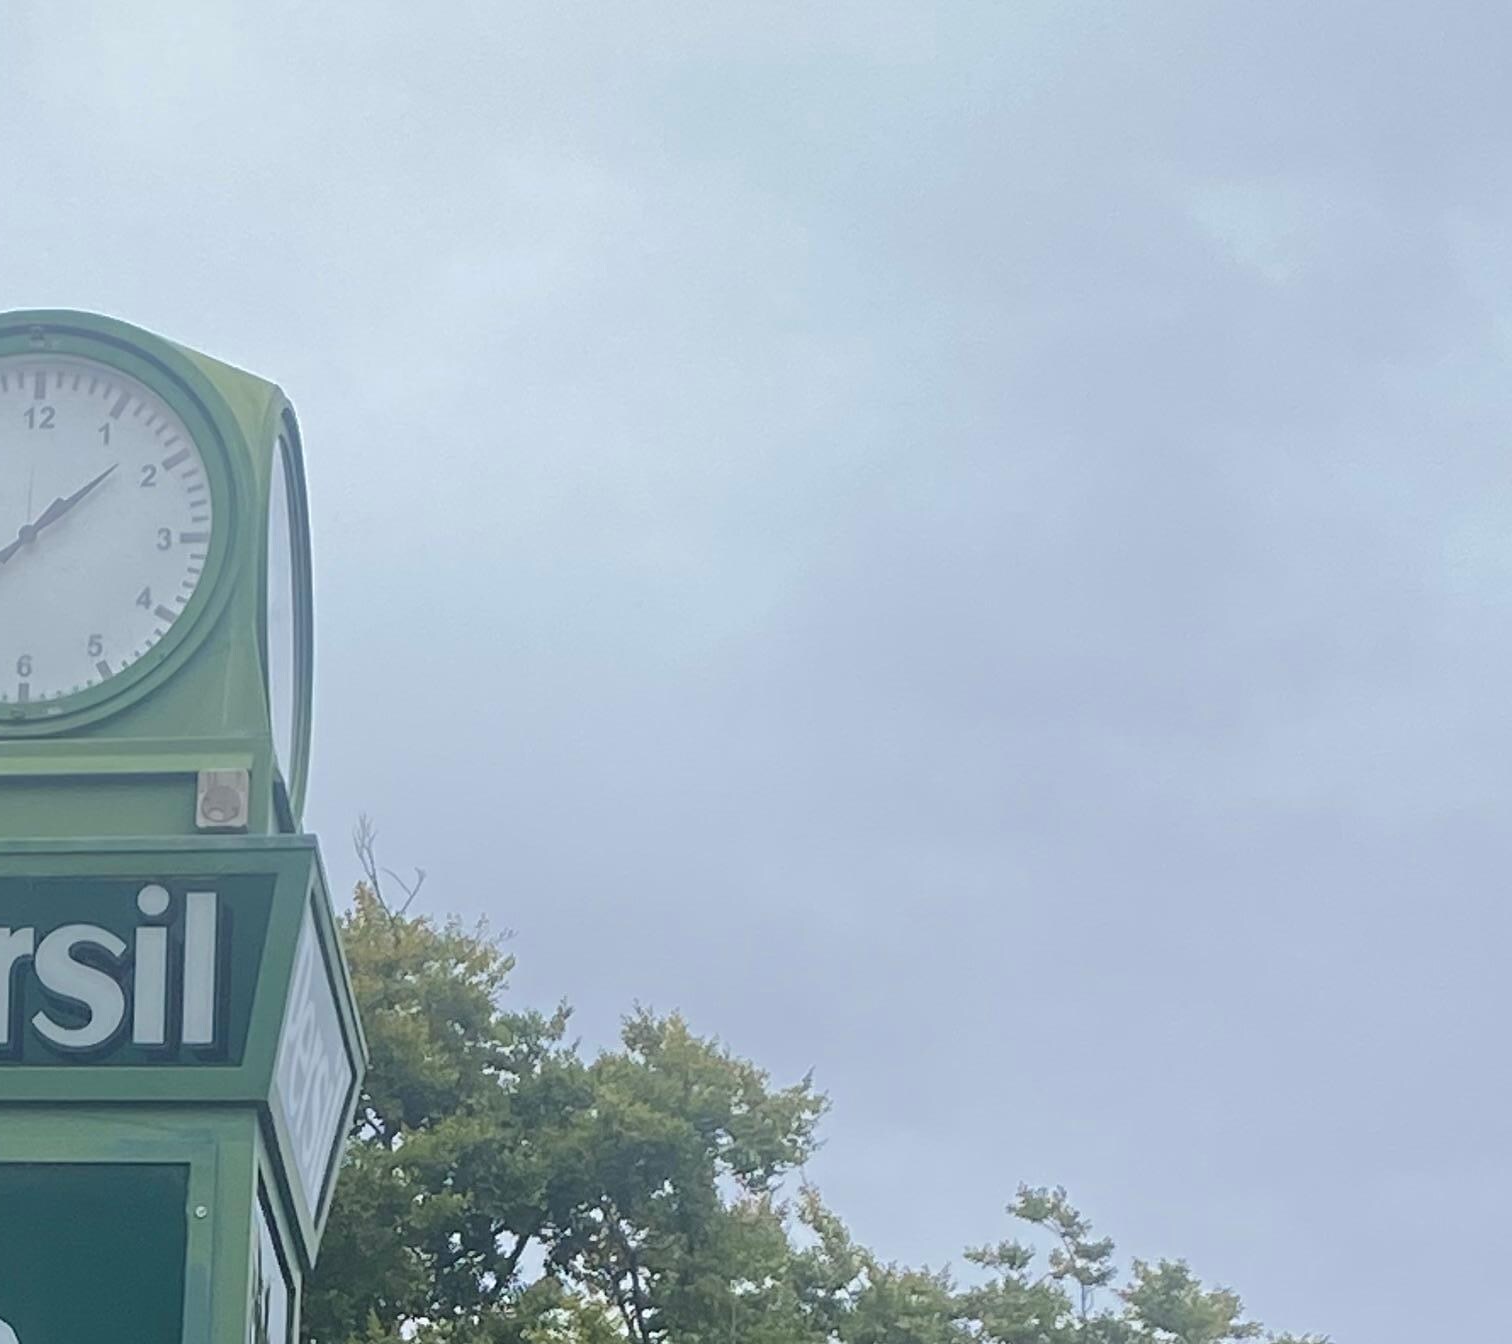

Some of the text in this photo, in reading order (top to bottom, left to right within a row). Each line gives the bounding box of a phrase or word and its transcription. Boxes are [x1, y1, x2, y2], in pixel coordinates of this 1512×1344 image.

[23, 405, 57, 430] 12
[98, 423, 111, 446] 1
[140, 462, 158, 488] 2
[155, 527, 173, 552] 3
[135, 587, 153, 611] 4
[87, 633, 104, 658] 5
[16, 654, 33, 678] 6
